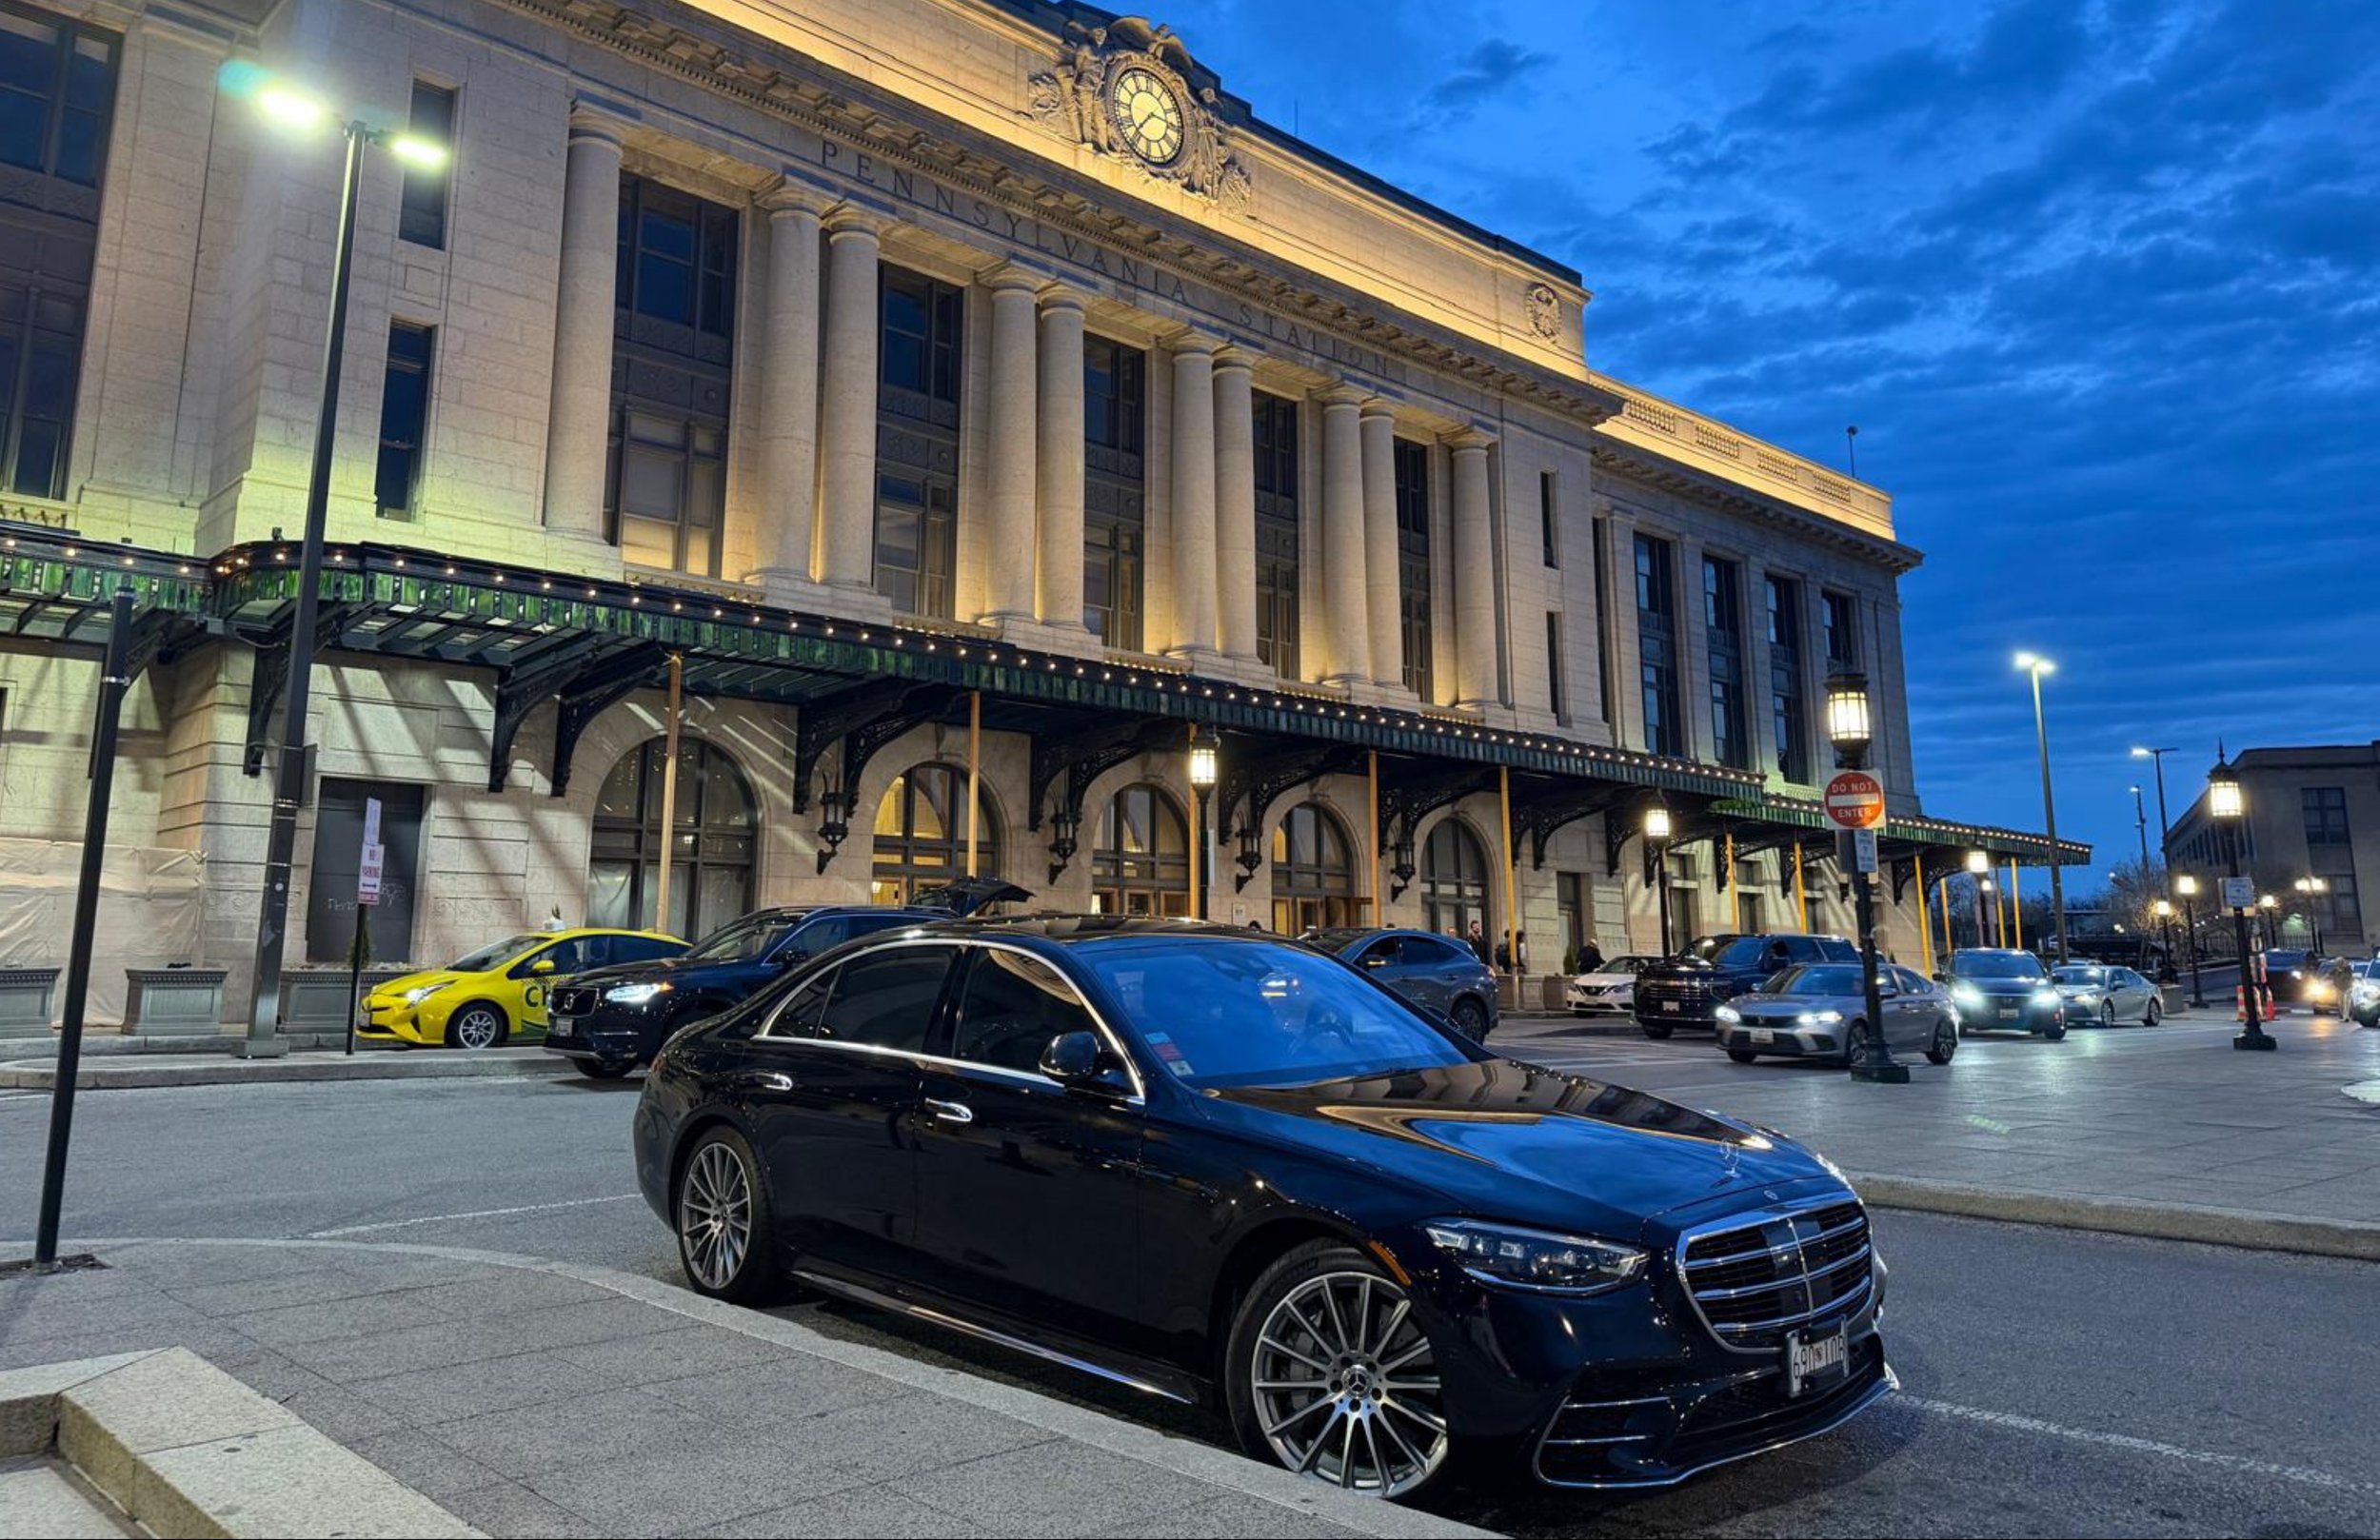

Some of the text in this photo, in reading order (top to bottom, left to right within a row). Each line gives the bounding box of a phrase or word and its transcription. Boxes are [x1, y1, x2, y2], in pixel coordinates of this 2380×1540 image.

[822, 140, 1388, 376] PENNSYLVANIA STATION
[1832, 781, 1873, 794] DO NOT
[1837, 807, 1873, 819] ENTER
